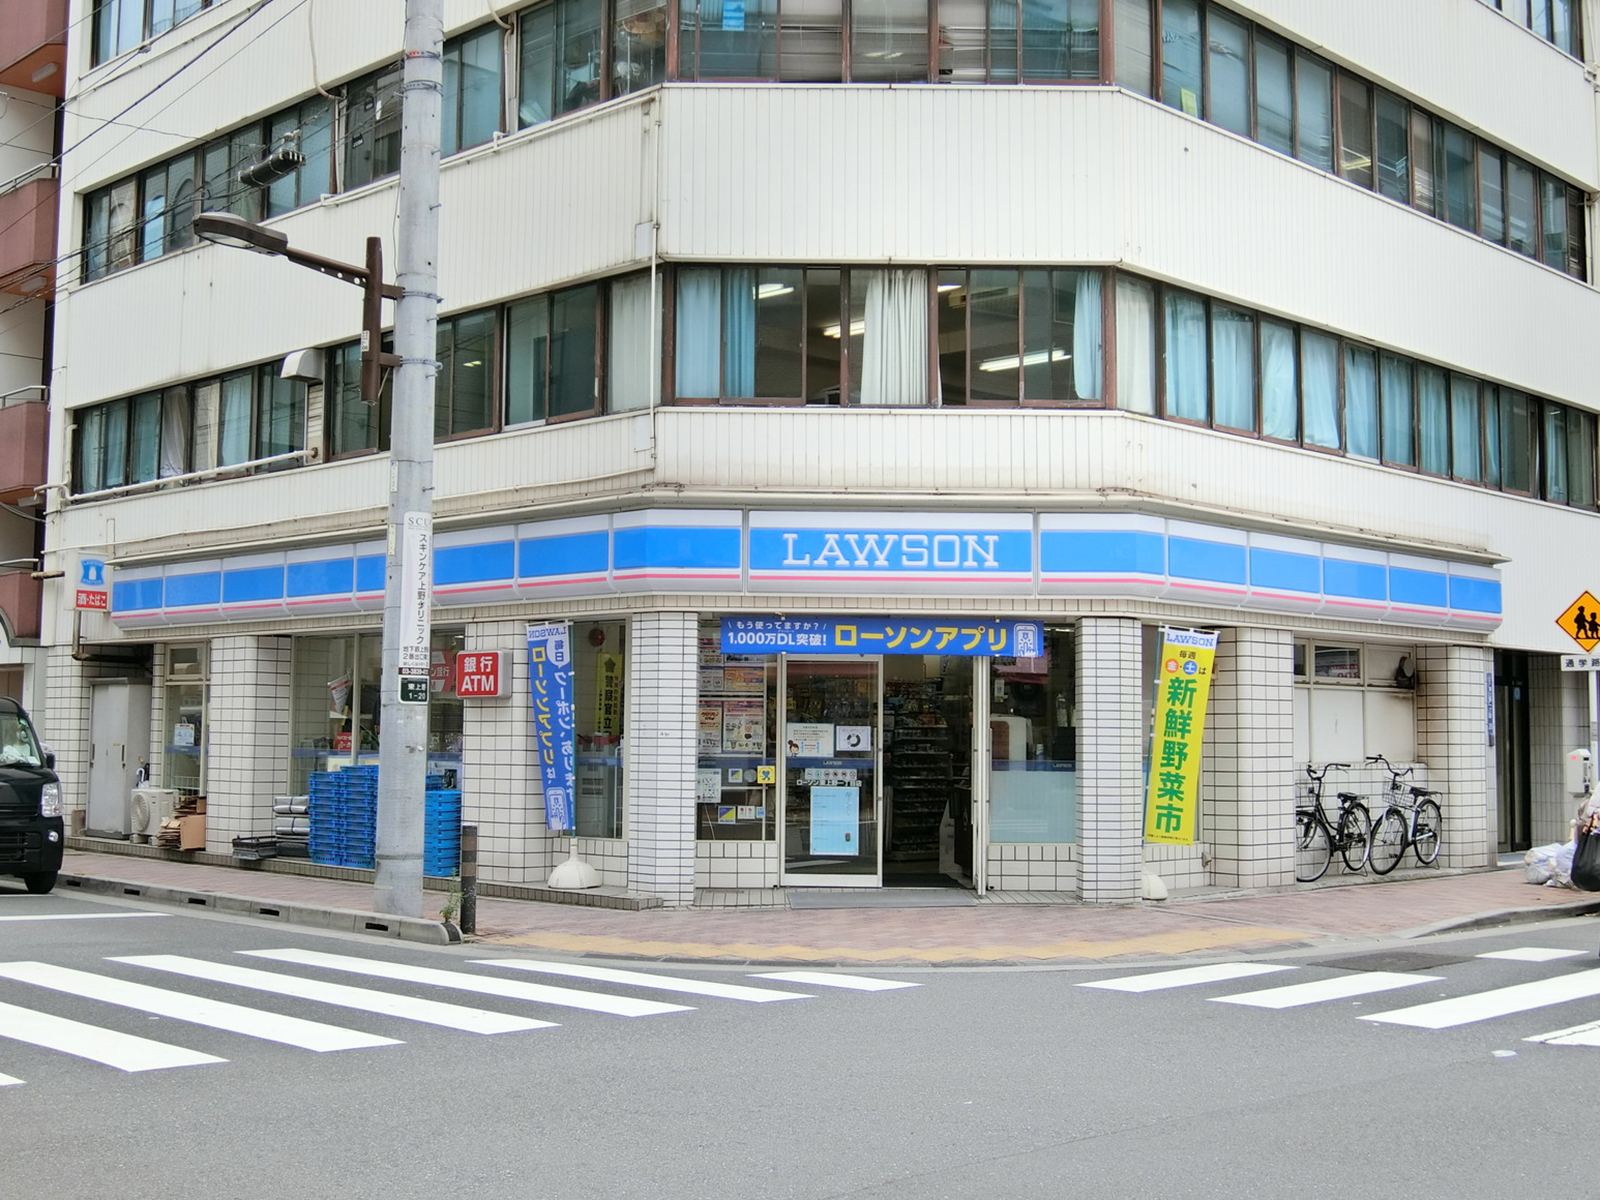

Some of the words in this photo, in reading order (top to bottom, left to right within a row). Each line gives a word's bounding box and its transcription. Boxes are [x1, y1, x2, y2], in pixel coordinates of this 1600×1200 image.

[782, 532, 1000, 568] LAWSON
[416, 533, 427, 645] スキンケア上野クリニック
[834, 624, 1008, 651] ローソンアプリ
[1165, 632, 1214, 648] LAWSON
[463, 656, 493, 673] 銀行
[1179, 650, 1197, 660] 毎週
[461, 675, 495, 692] ATM
[1155, 676, 1198, 833] 新鮮野菜市
